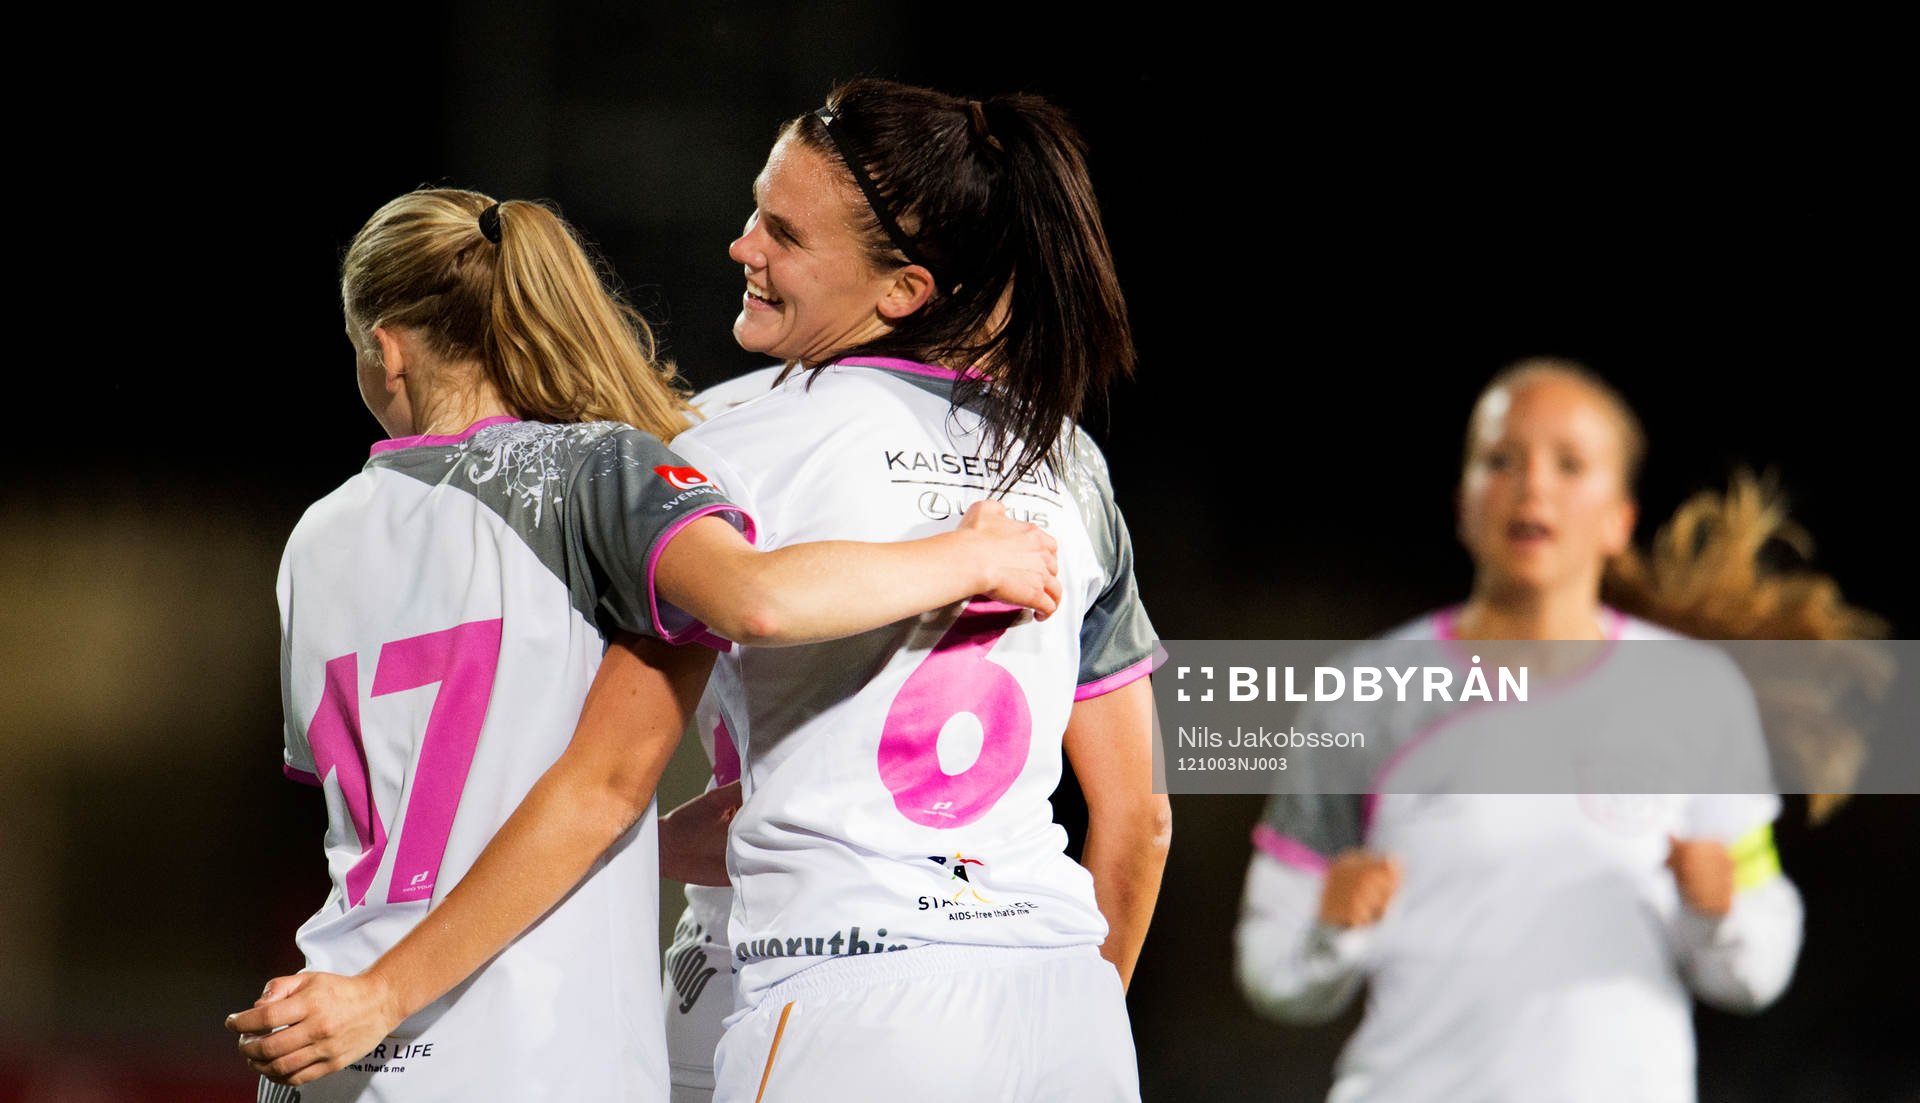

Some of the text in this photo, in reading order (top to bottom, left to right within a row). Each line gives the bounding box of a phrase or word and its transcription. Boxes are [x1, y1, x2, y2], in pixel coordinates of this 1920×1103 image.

[885, 451, 1006, 480] KAISER
[878, 594, 1033, 829] 6
[306, 618, 503, 909] 17
[949, 911, 993, 921] AIDS-free
[393, 1043, 434, 1059] LIFE
[364, 1063, 389, 1073] that's
